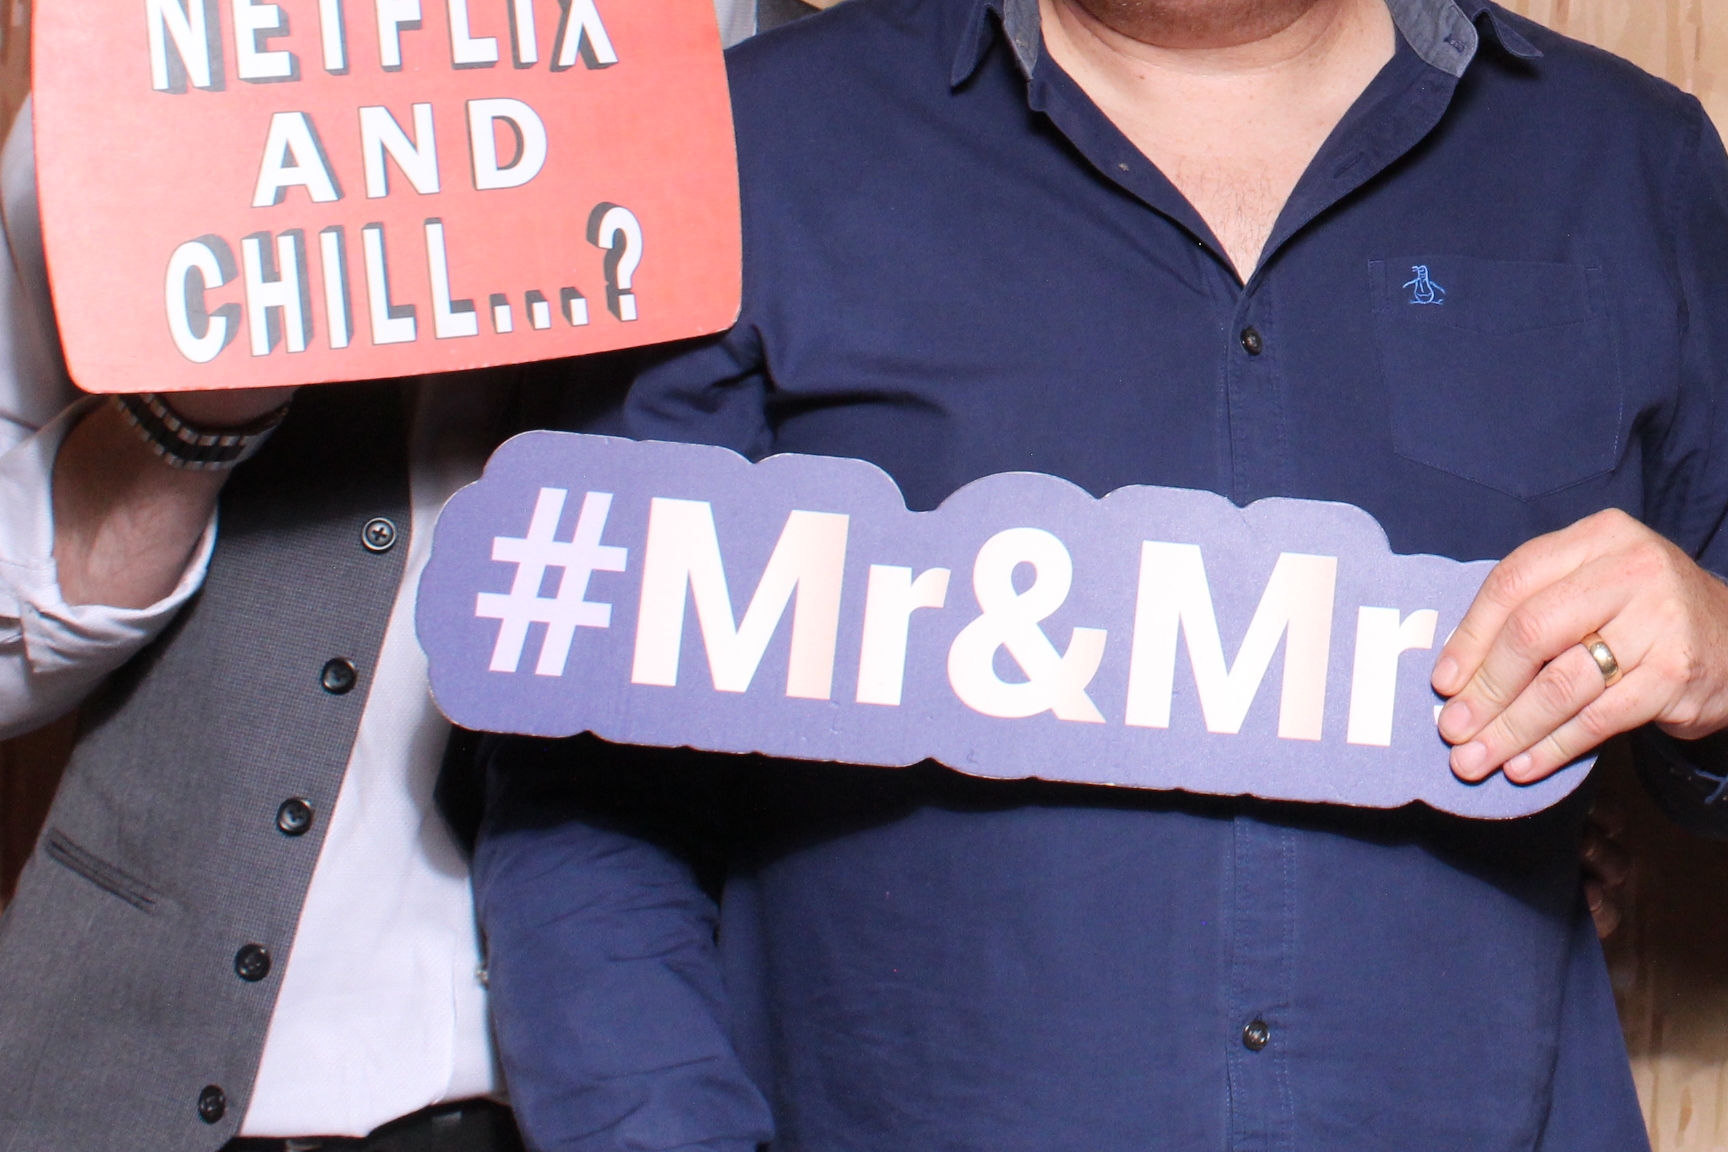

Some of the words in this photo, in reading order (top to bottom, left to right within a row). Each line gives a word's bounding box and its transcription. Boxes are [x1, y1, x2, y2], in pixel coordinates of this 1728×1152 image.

[251, 97, 548, 208] AND
[164, 202, 643, 364] CHILL...?
[474, 486, 1457, 747] #Mr&Mr
